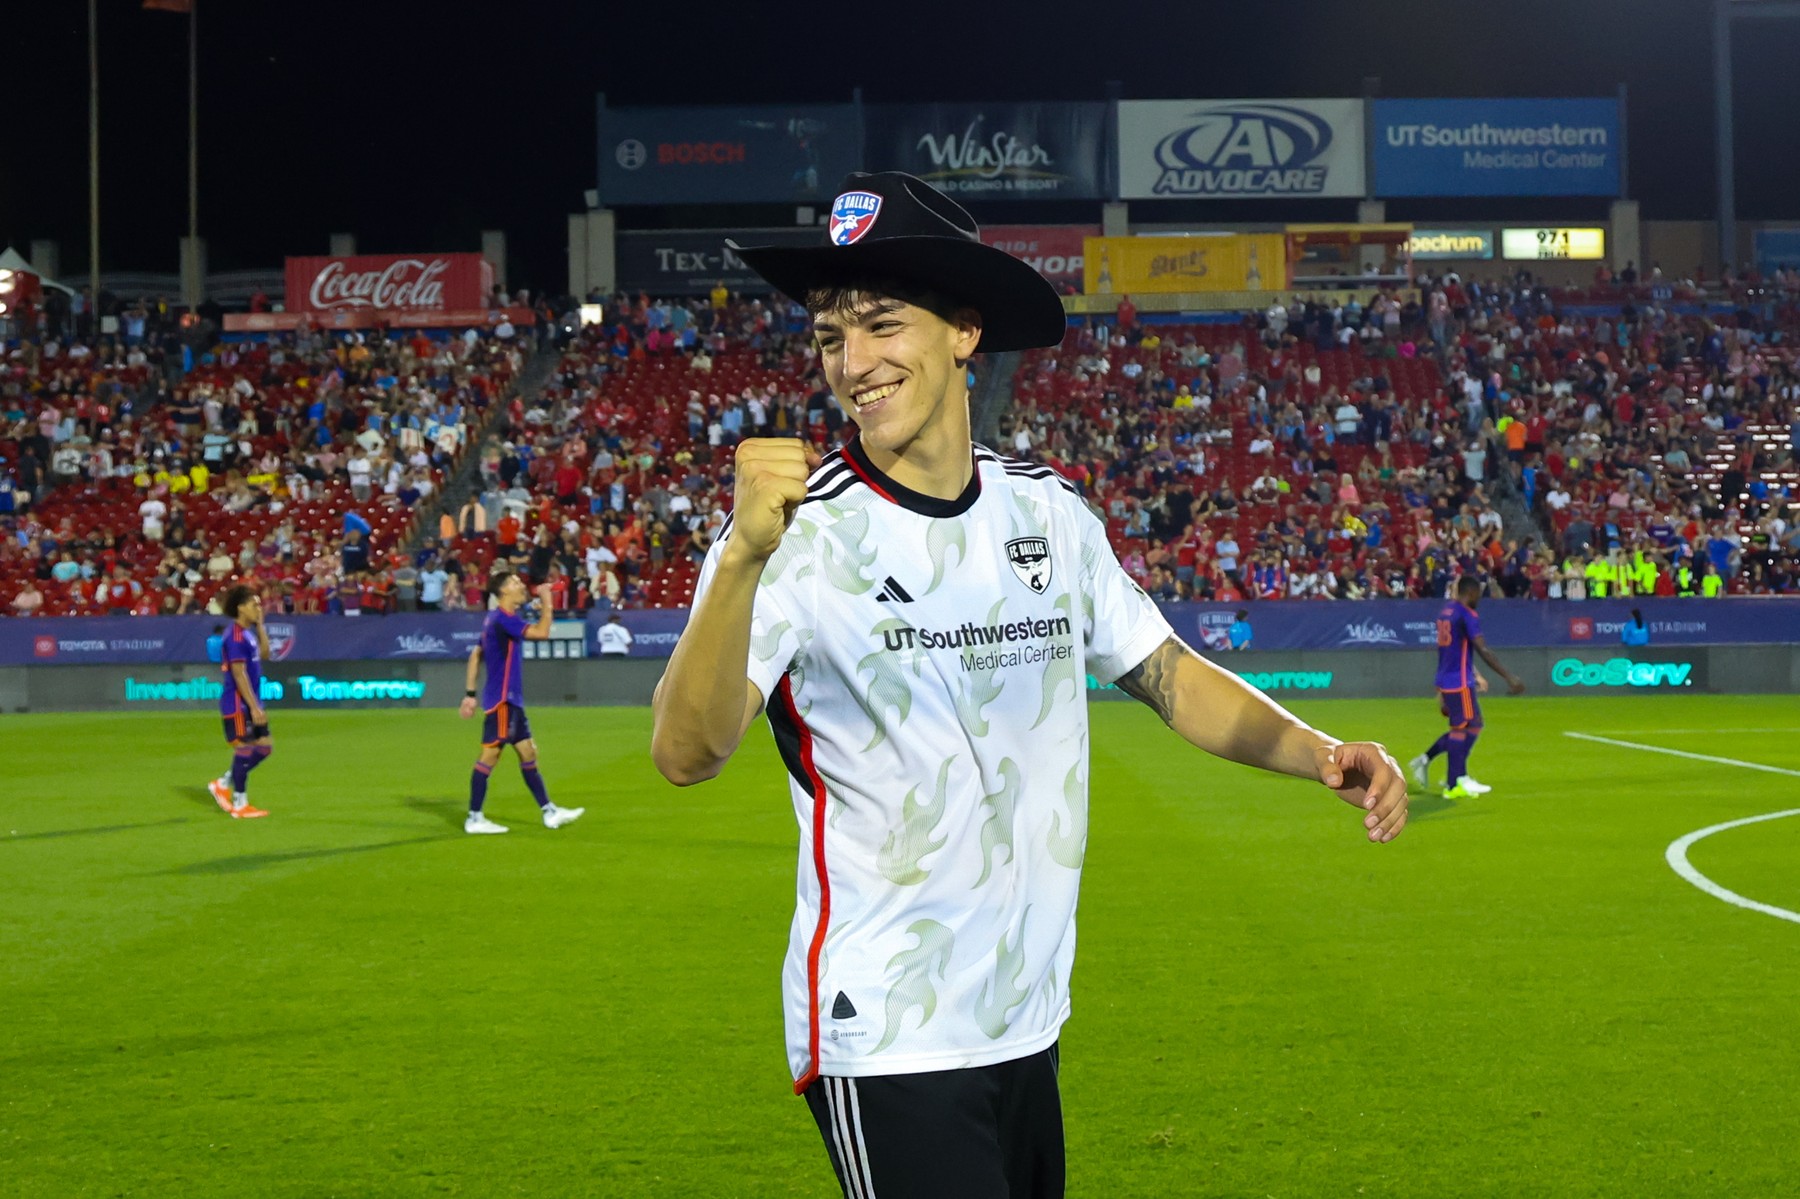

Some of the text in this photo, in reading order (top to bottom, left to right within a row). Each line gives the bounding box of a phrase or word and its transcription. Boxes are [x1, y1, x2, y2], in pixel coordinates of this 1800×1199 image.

[1386, 123, 1607, 147] UT Southwestern
[657, 143, 745, 164] BOSCH
[916, 114, 1054, 178] WinStar
[1463, 151, 1606, 168] Medical Center
[1153, 167, 1328, 194] ADVOCARE
[844, 195, 876, 211] DALLAS
[655, 248, 748, 271] TEX-M
[1022, 256, 1084, 273] HOP
[1008, 541, 1046, 560] FC DALLAS
[883, 615, 1071, 651] UT Southwestern
[1650, 622, 1706, 633] STADIUM
[58, 640, 107, 651] TOYOTA
[633, 633, 680, 645] TOYOTA
[959, 642, 1074, 673] Medical Center
[125, 676, 426, 700] Investin in Tomorrow
